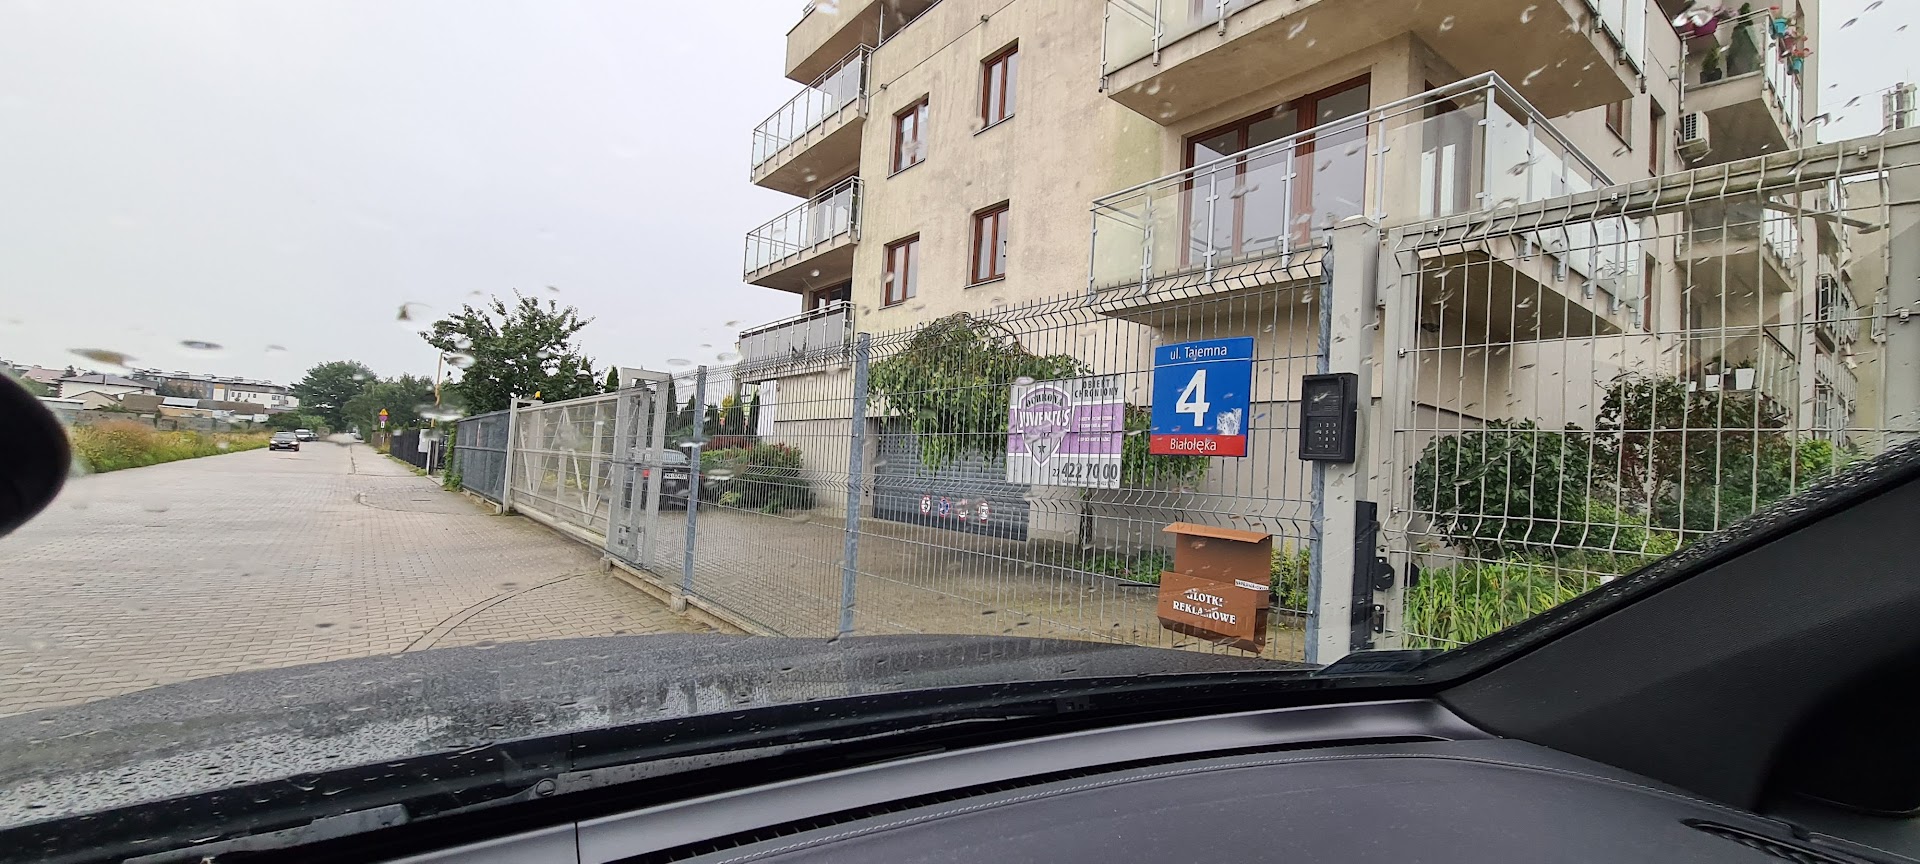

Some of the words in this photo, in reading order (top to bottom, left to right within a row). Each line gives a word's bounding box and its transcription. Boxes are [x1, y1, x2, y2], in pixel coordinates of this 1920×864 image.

[1170, 347, 1181, 360] ul.
[1185, 345, 1228, 361] Tajemna
[1175, 369, 1211, 427] 4
[1019, 408, 1071, 428] JUVENTUS
[1170, 438, 1217, 454] Białołęka
[1102, 463, 1118, 480] 00
